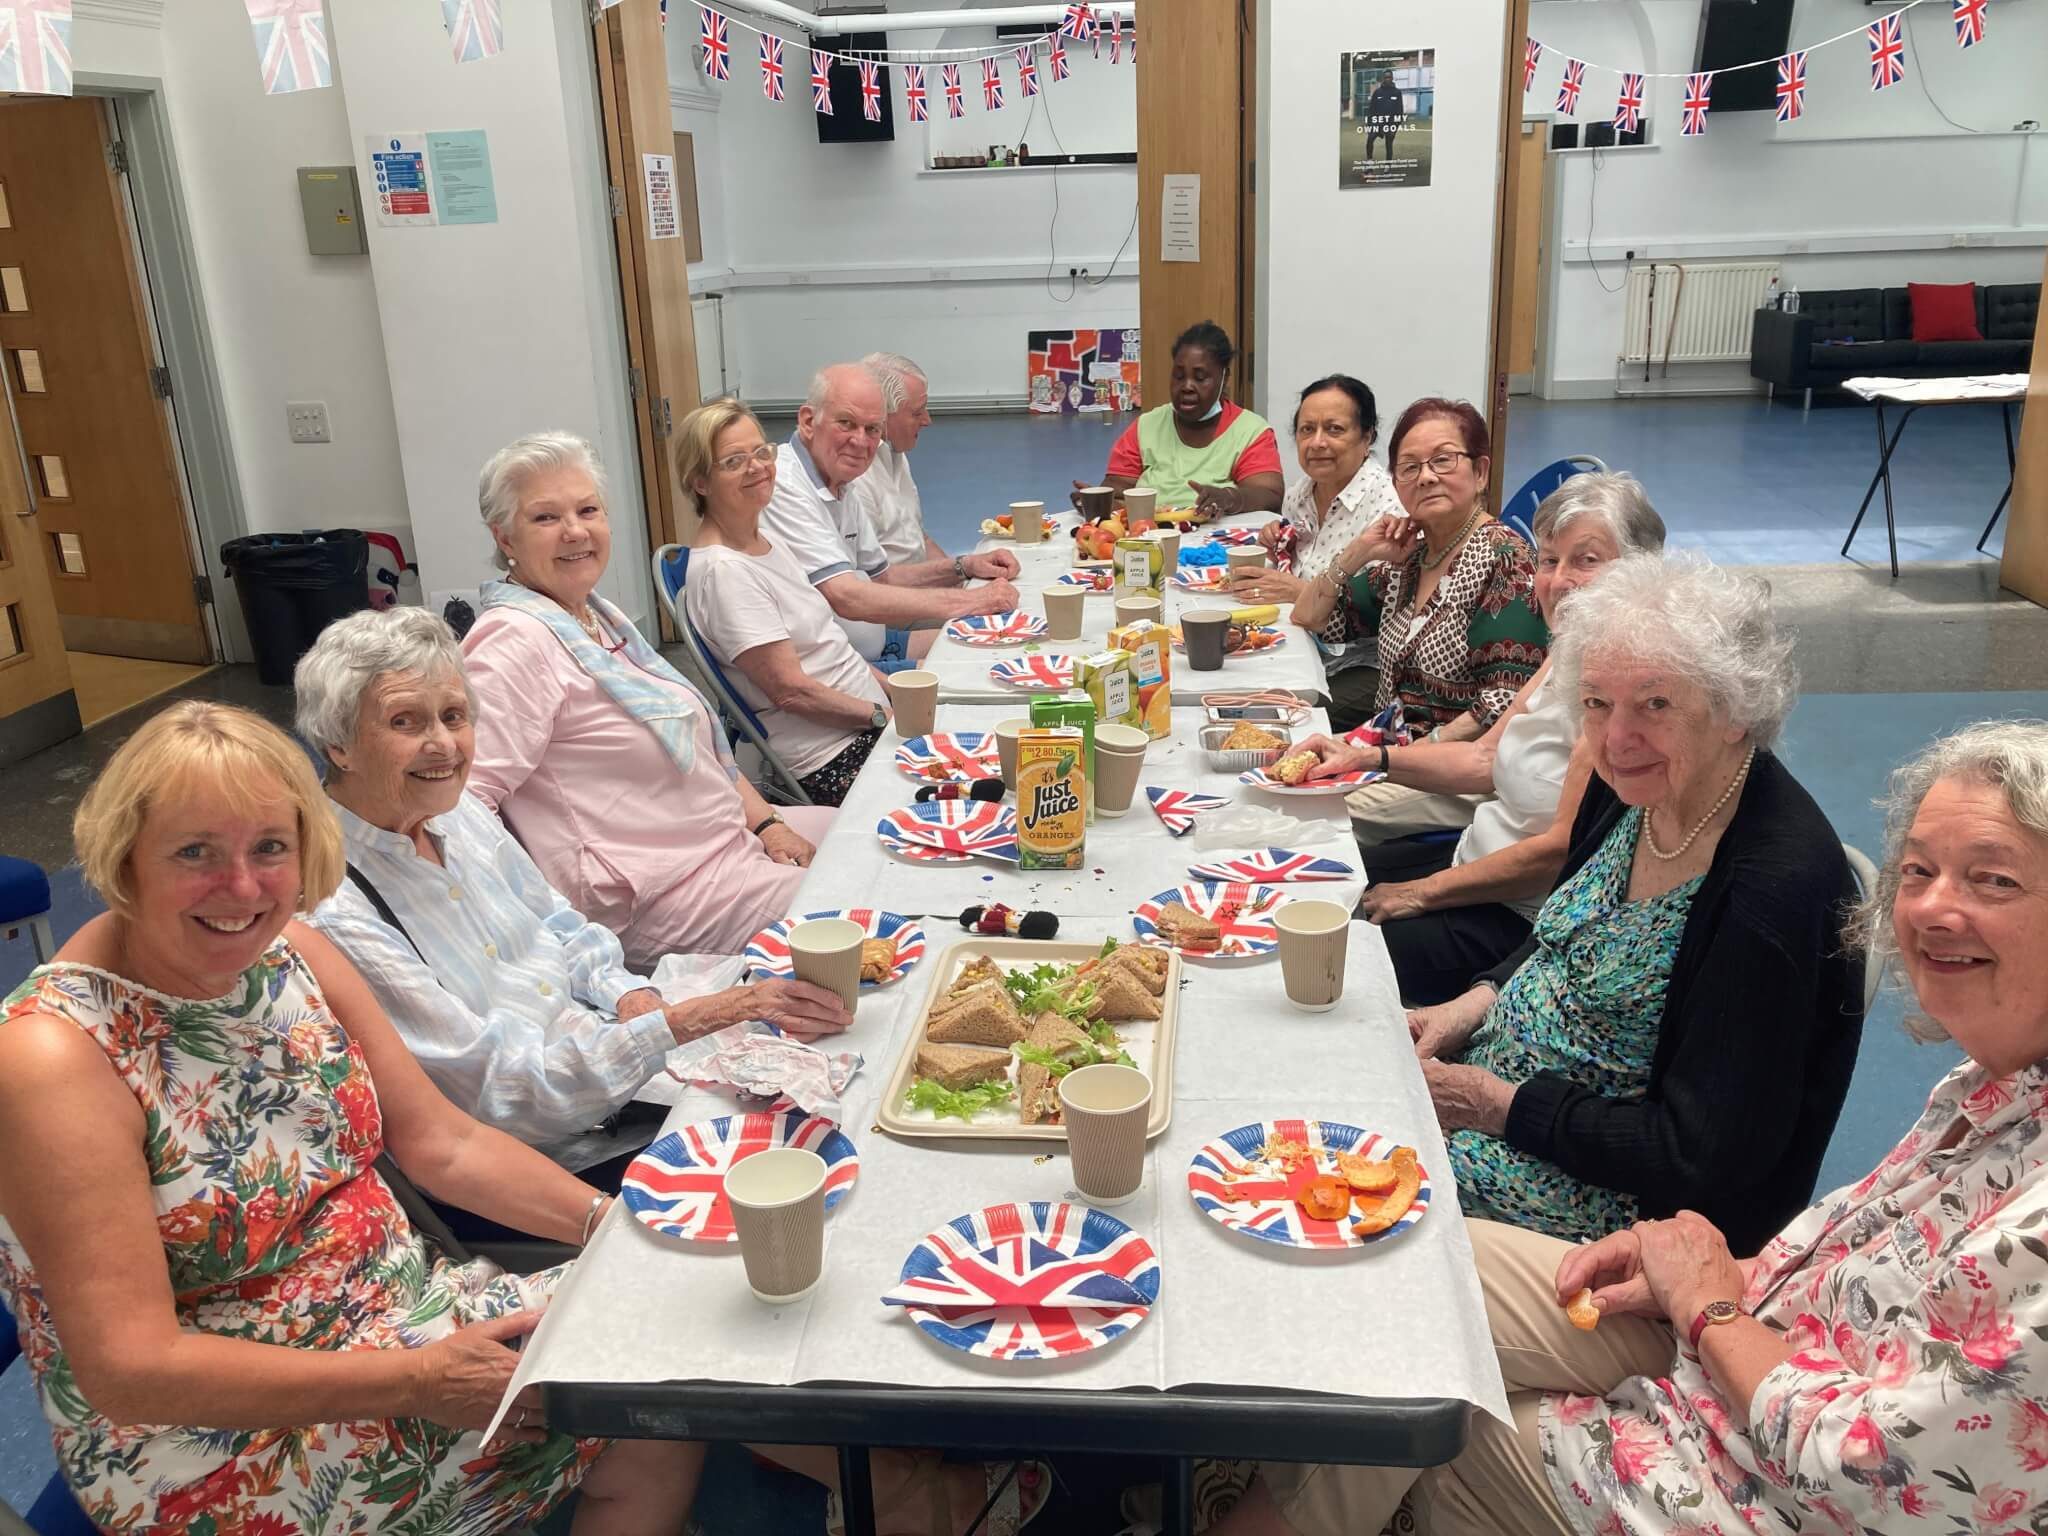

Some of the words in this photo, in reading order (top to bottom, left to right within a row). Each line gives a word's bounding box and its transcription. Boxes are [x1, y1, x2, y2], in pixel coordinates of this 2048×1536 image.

[1371, 115, 1390, 123] SET
[1393, 114, 1408, 122] MY
[1356, 126, 1379, 134] OWN
[1383, 124, 1416, 132] GOALS
[1110, 692, 1124, 700] APPLE
